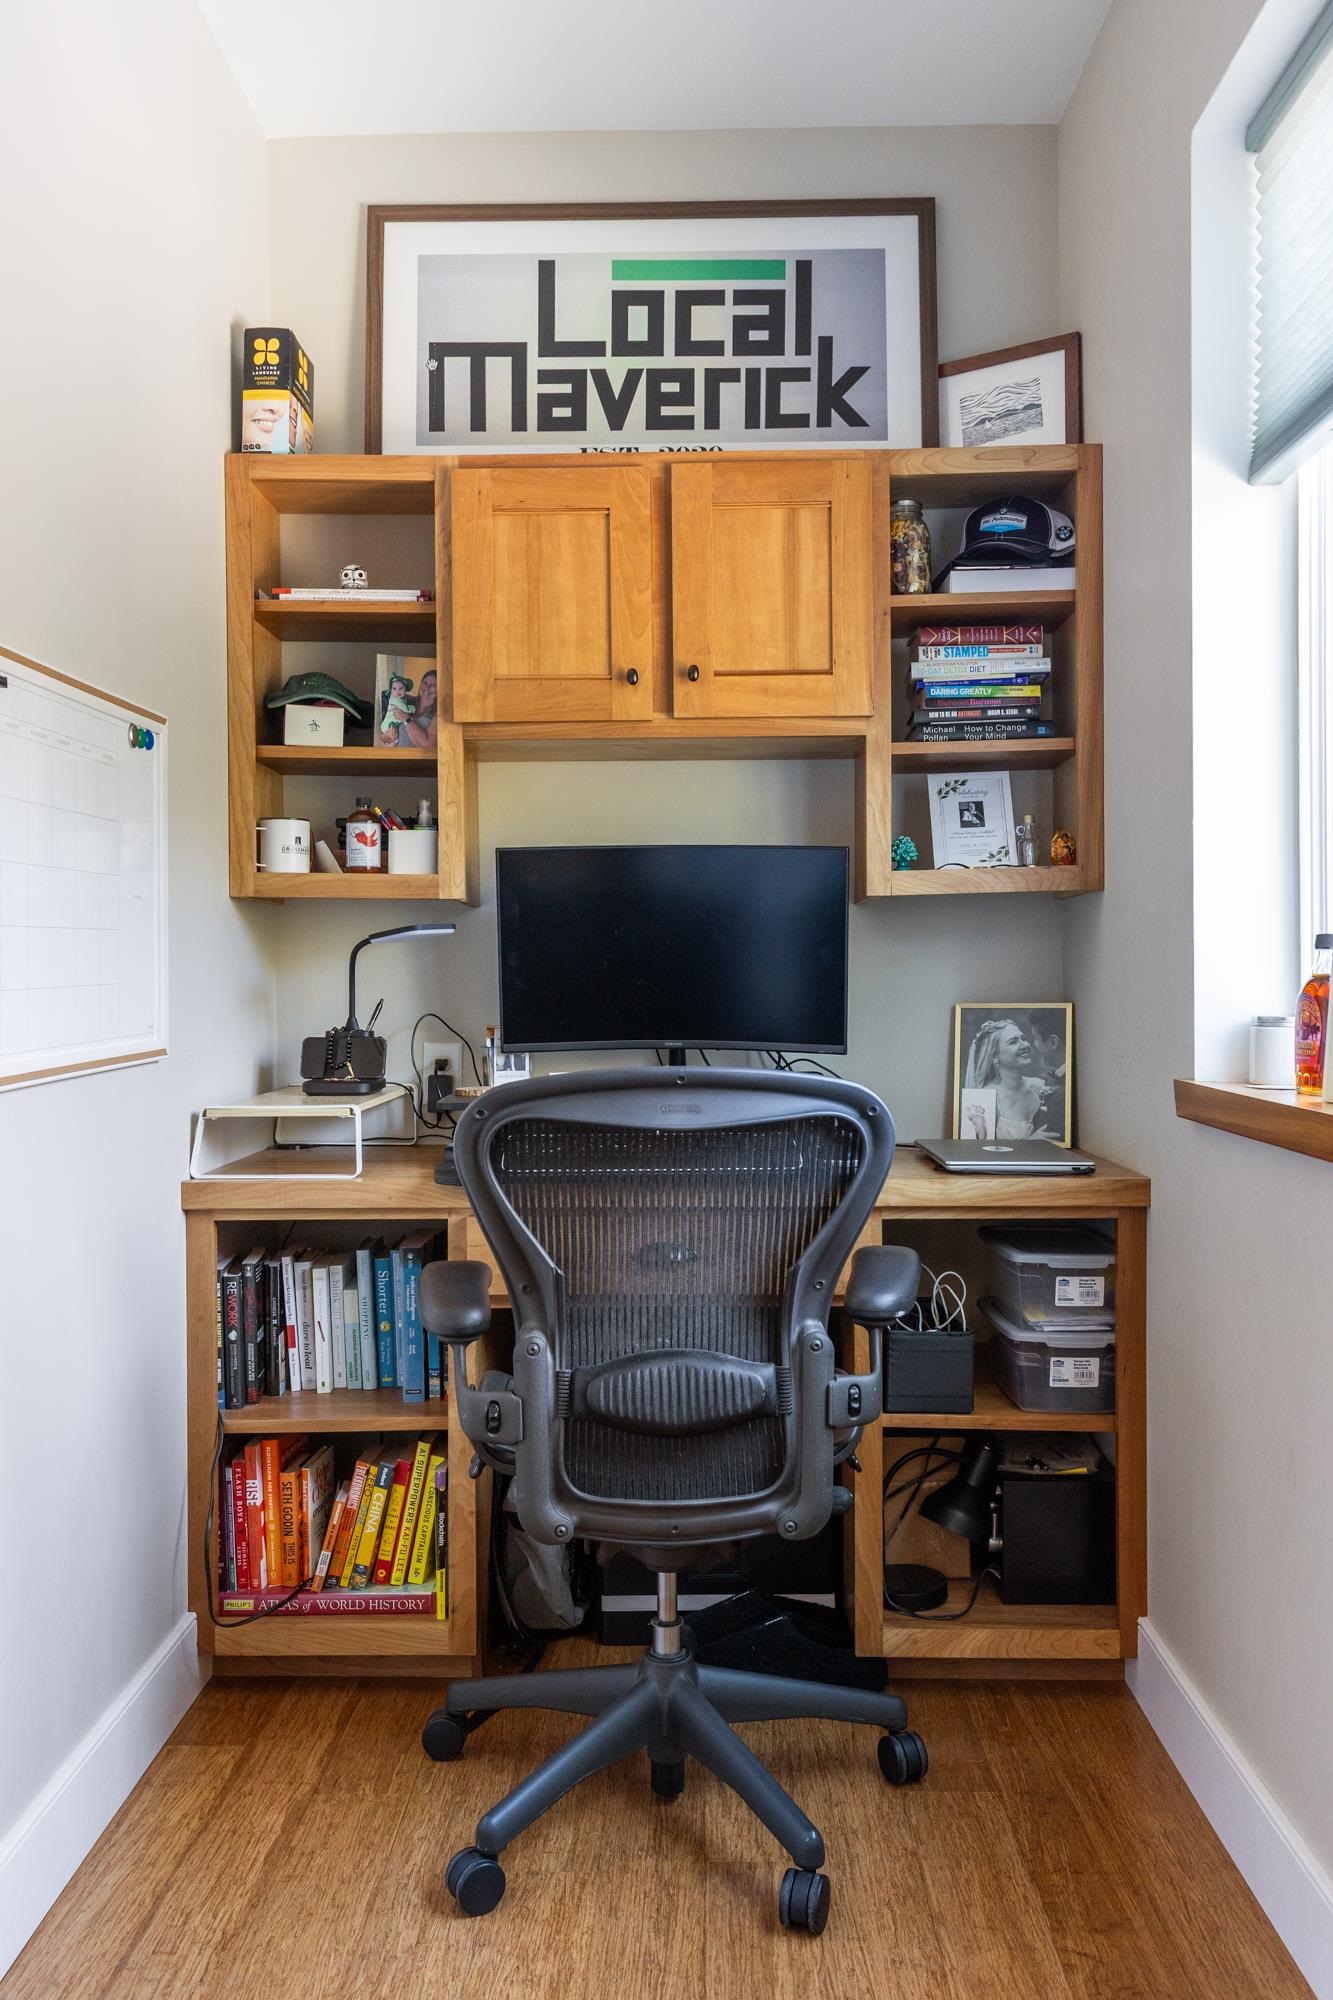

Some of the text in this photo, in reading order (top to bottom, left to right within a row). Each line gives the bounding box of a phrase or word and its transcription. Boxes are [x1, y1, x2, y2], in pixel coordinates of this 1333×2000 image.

[537, 258, 813, 358] Local
[943, 646, 989, 658] STAMPED
[969, 665, 986, 673] DIET
[923, 726, 956, 734] Michael
[995, 724, 1027, 734] Change
[923, 732, 1007, 742] Pollan Your Mind
[227, 1281, 238, 1327] REWORK
[332, 1280, 341, 1304] blink
[377, 1270, 389, 1314] Shorter
[361, 1296, 370, 1340] SHOPPING
[303, 1321, 313, 1370] dare to lead
[246, 1479, 258, 1507] RISE
[346, 1461, 369, 1510] FREAKONOMICS
[364, 1472, 377, 1498] ZERO
[236, 1500, 244, 1523] BOYS
[282, 1481, 293, 1537] SETH GODIN
[366, 1493, 384, 1533] CHINA
[395, 1448, 426, 1574] AI SUPERPOWERS KAI-FU LEE
[423, 1486, 435, 1525] CONSCIOUS
[416, 1526, 429, 1564] CAPITALISM
[438, 1512, 446, 1546] Blockchain
[287, 1543, 295, 1557] THIS
[302, 1600, 312, 1612] of
[316, 1599, 365, 1610] WORLD
[369, 1599, 425, 1610] HISTORY
